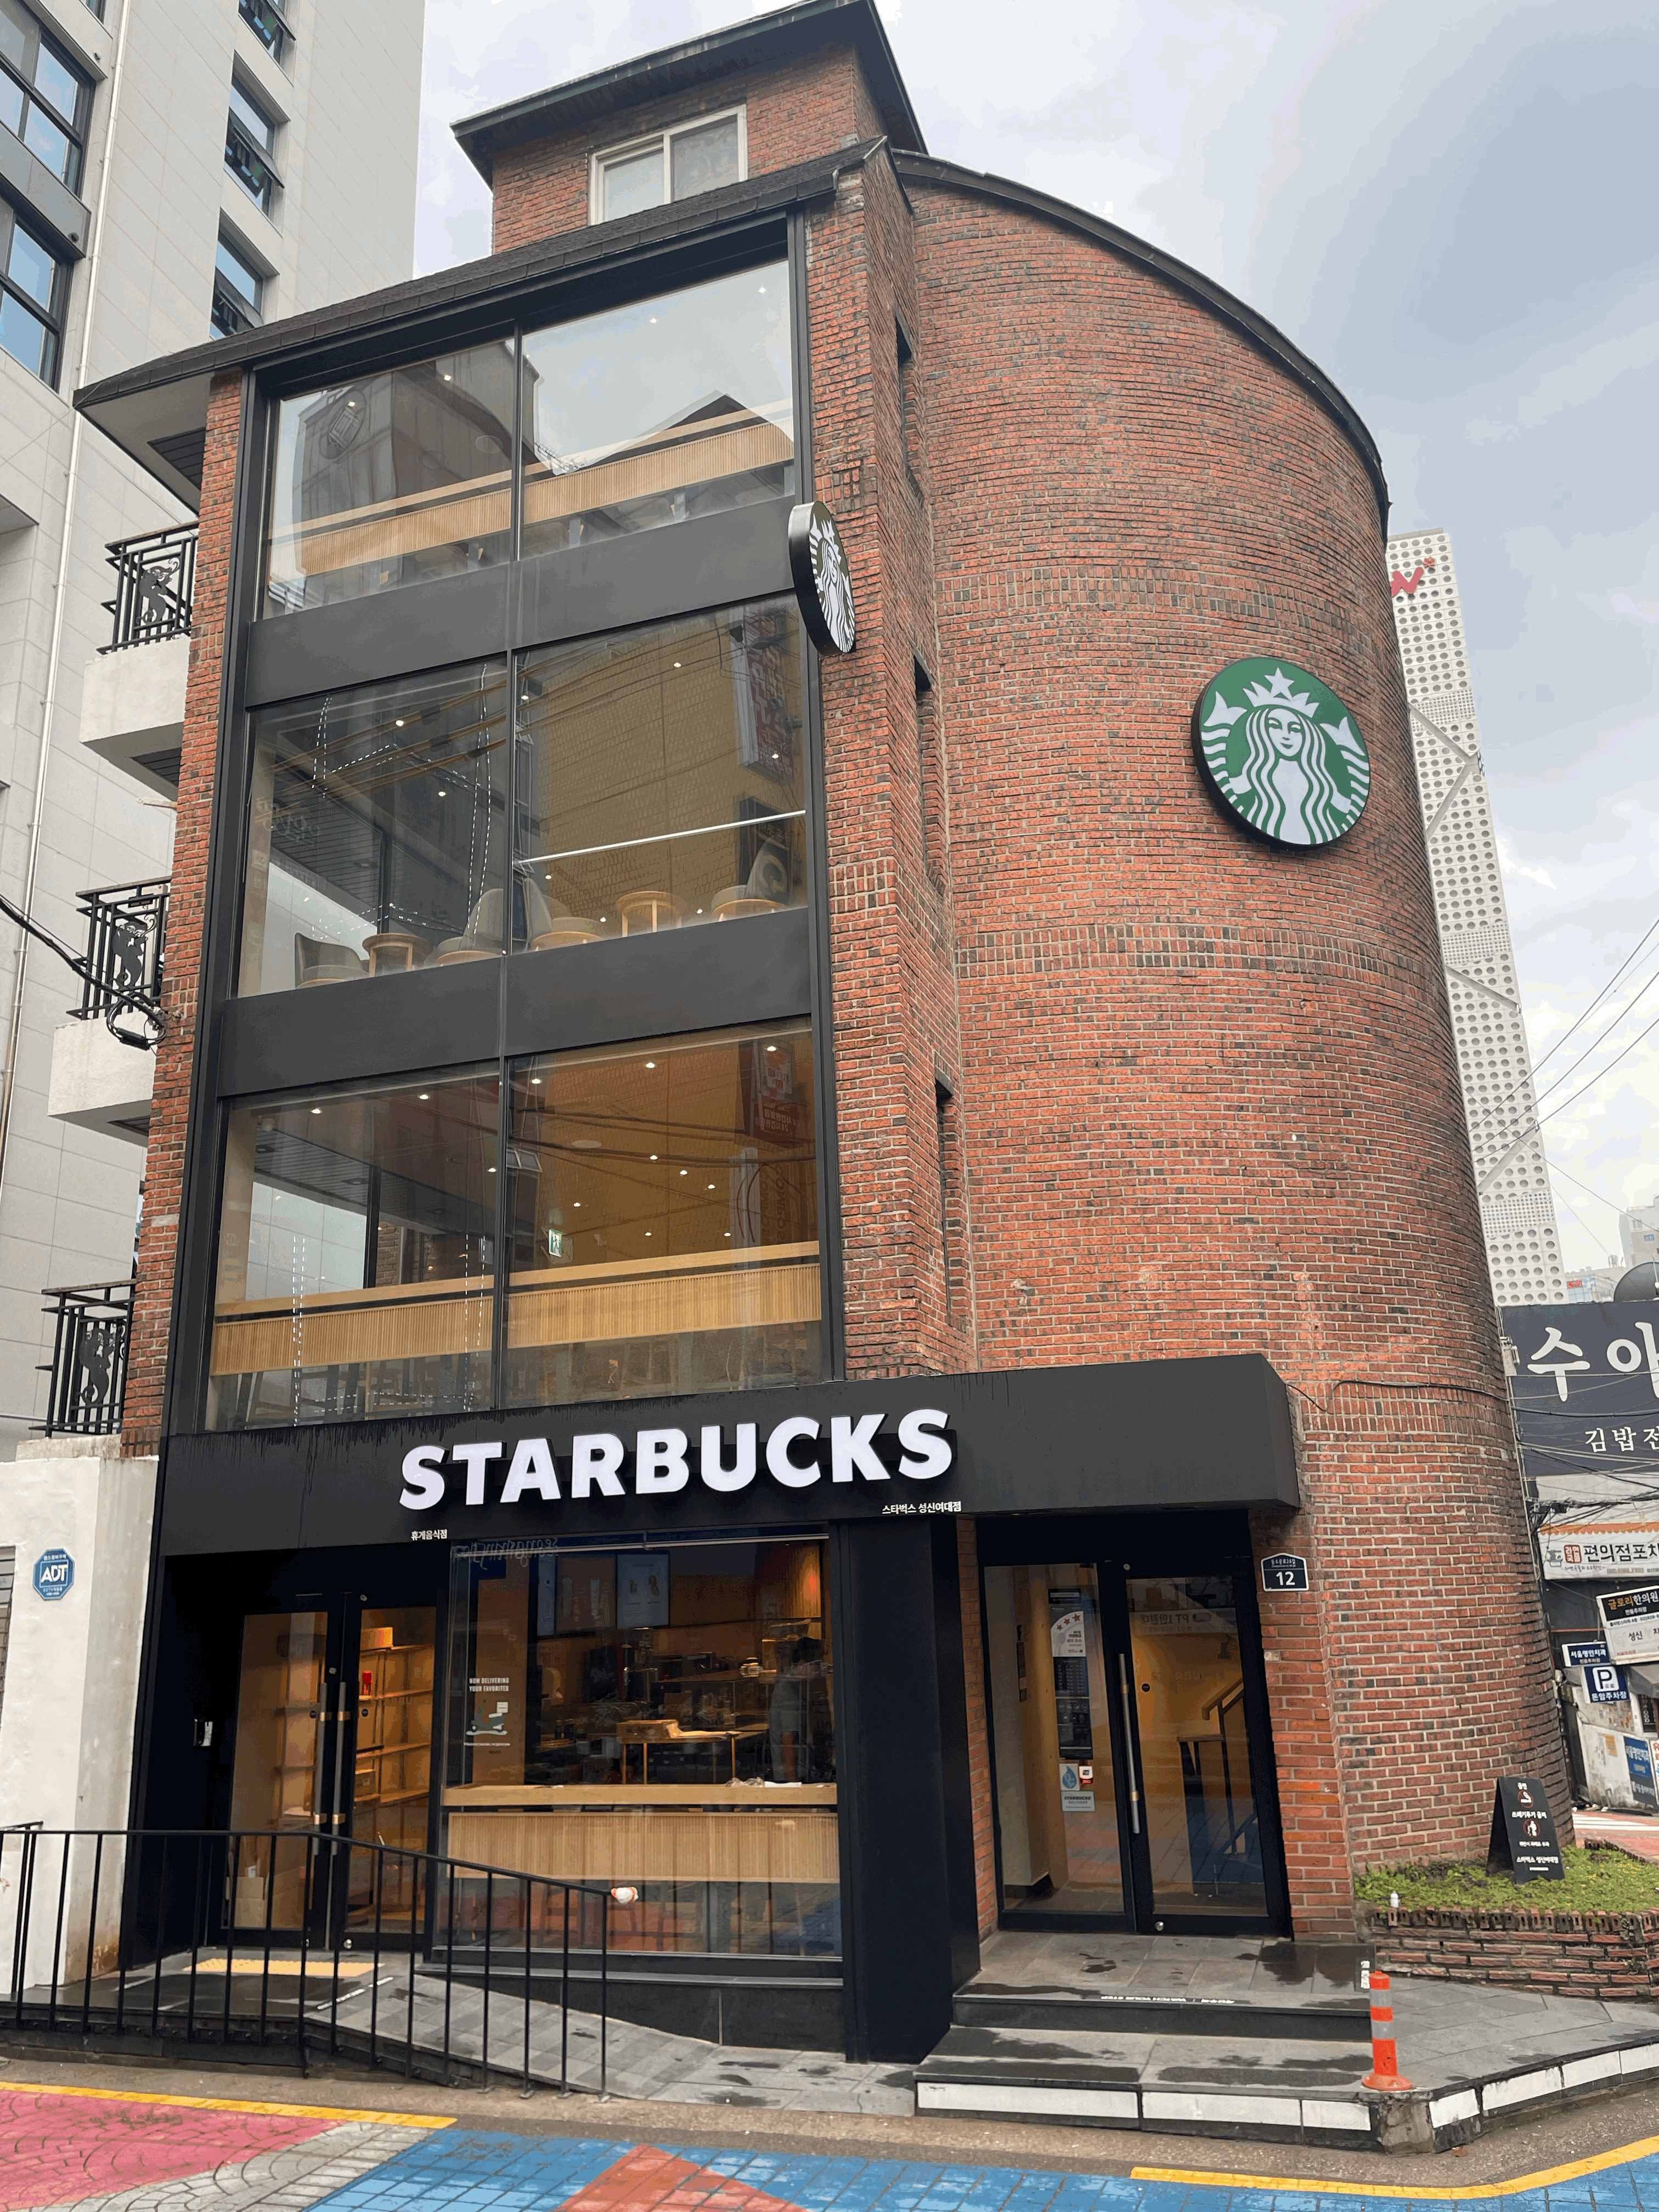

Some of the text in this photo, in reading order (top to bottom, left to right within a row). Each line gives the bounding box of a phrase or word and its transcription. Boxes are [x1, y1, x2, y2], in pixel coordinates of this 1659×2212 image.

[399, 1408, 953, 1510] STARBUCKS
[882, 1501, 961, 1514] 스타벅스 성신여대점
[411, 1529, 447, 1541] 휴게음식점
[41, 1564, 68, 1583] ADT
[1276, 1571, 1295, 1585] 12
[1597, 1669, 1612, 1689] P
